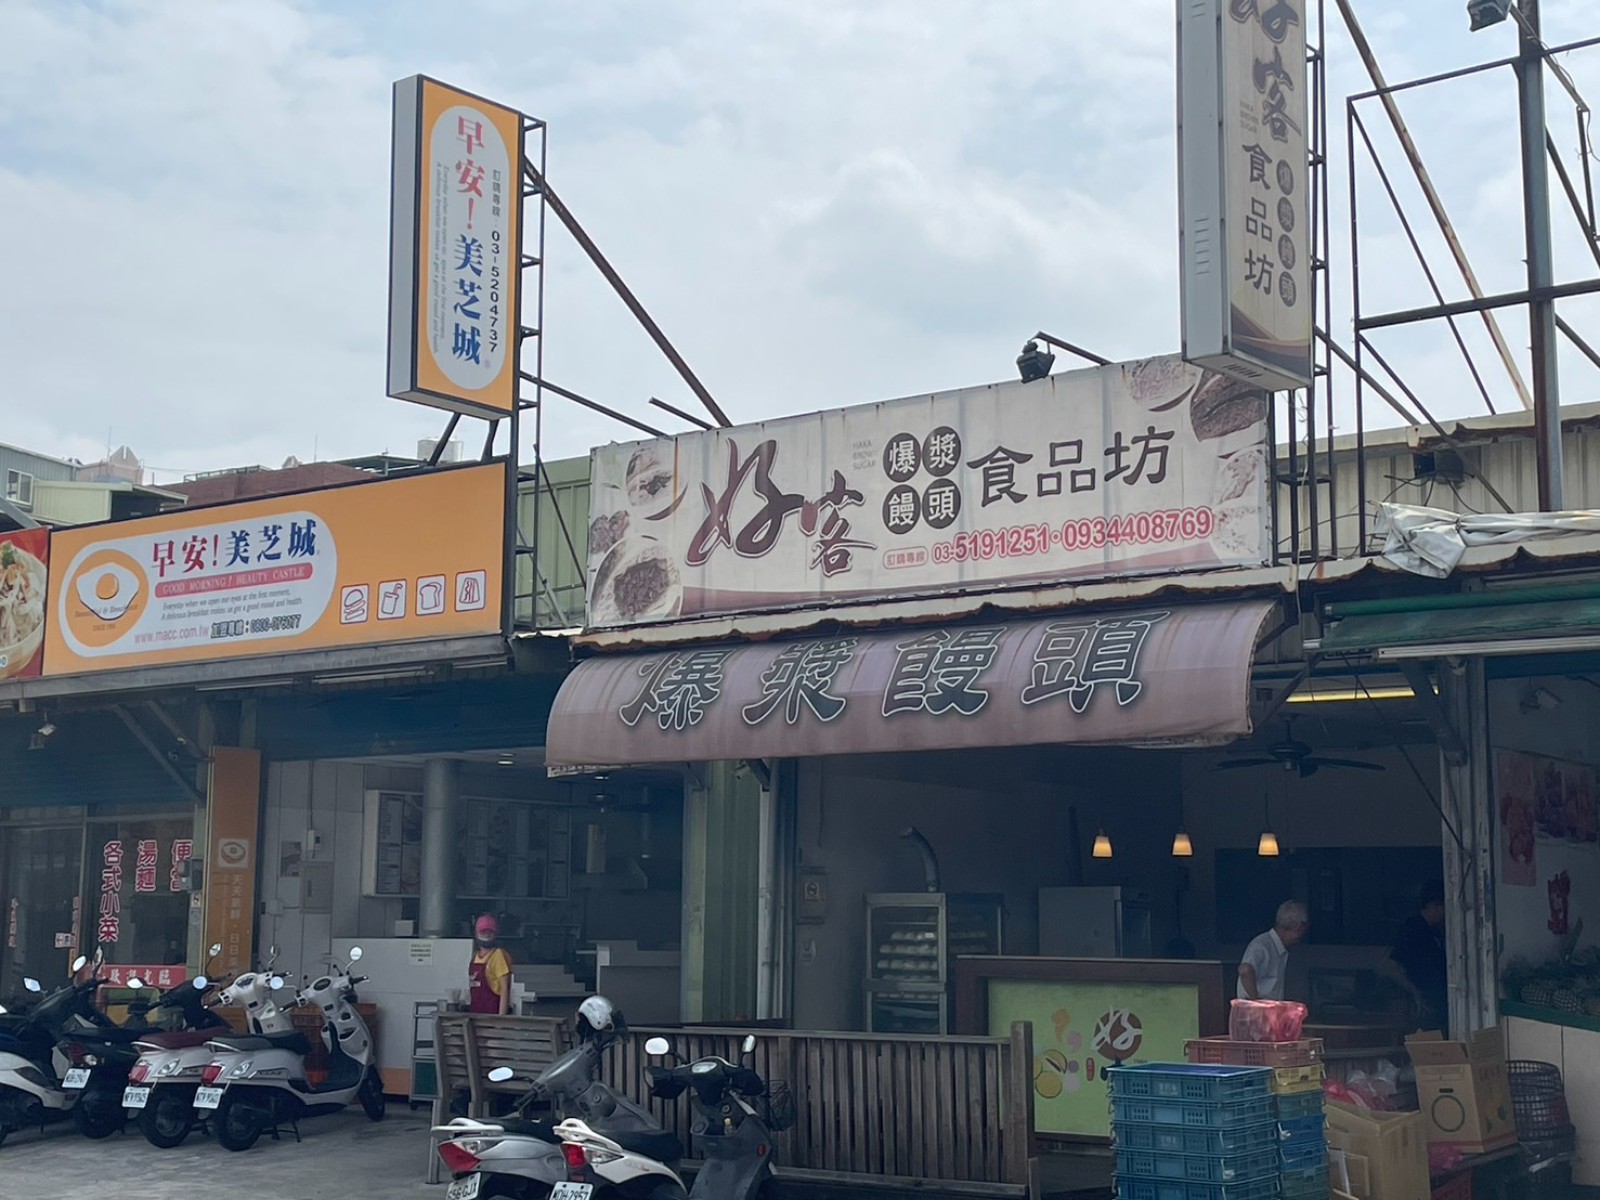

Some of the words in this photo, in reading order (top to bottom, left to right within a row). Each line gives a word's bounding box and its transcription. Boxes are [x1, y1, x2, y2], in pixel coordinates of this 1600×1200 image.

[1242, 143, 1273, 295] 食品坊
[489, 231, 501, 353] 03-5204737
[887, 433, 957, 475] 爆漿
[966, 426, 1176, 507] 食品坊
[888, 486, 956, 528] 饅頭
[162, 582, 185, 595] GOOD
[236, 572, 268, 586] BEAUTY
[272, 566, 306, 580] CASTLE
[618, 610, 1172, 732] 爆漿饅頭
[98, 840, 124, 943] 各式小菜
[135, 840, 158, 892] 湯麵
